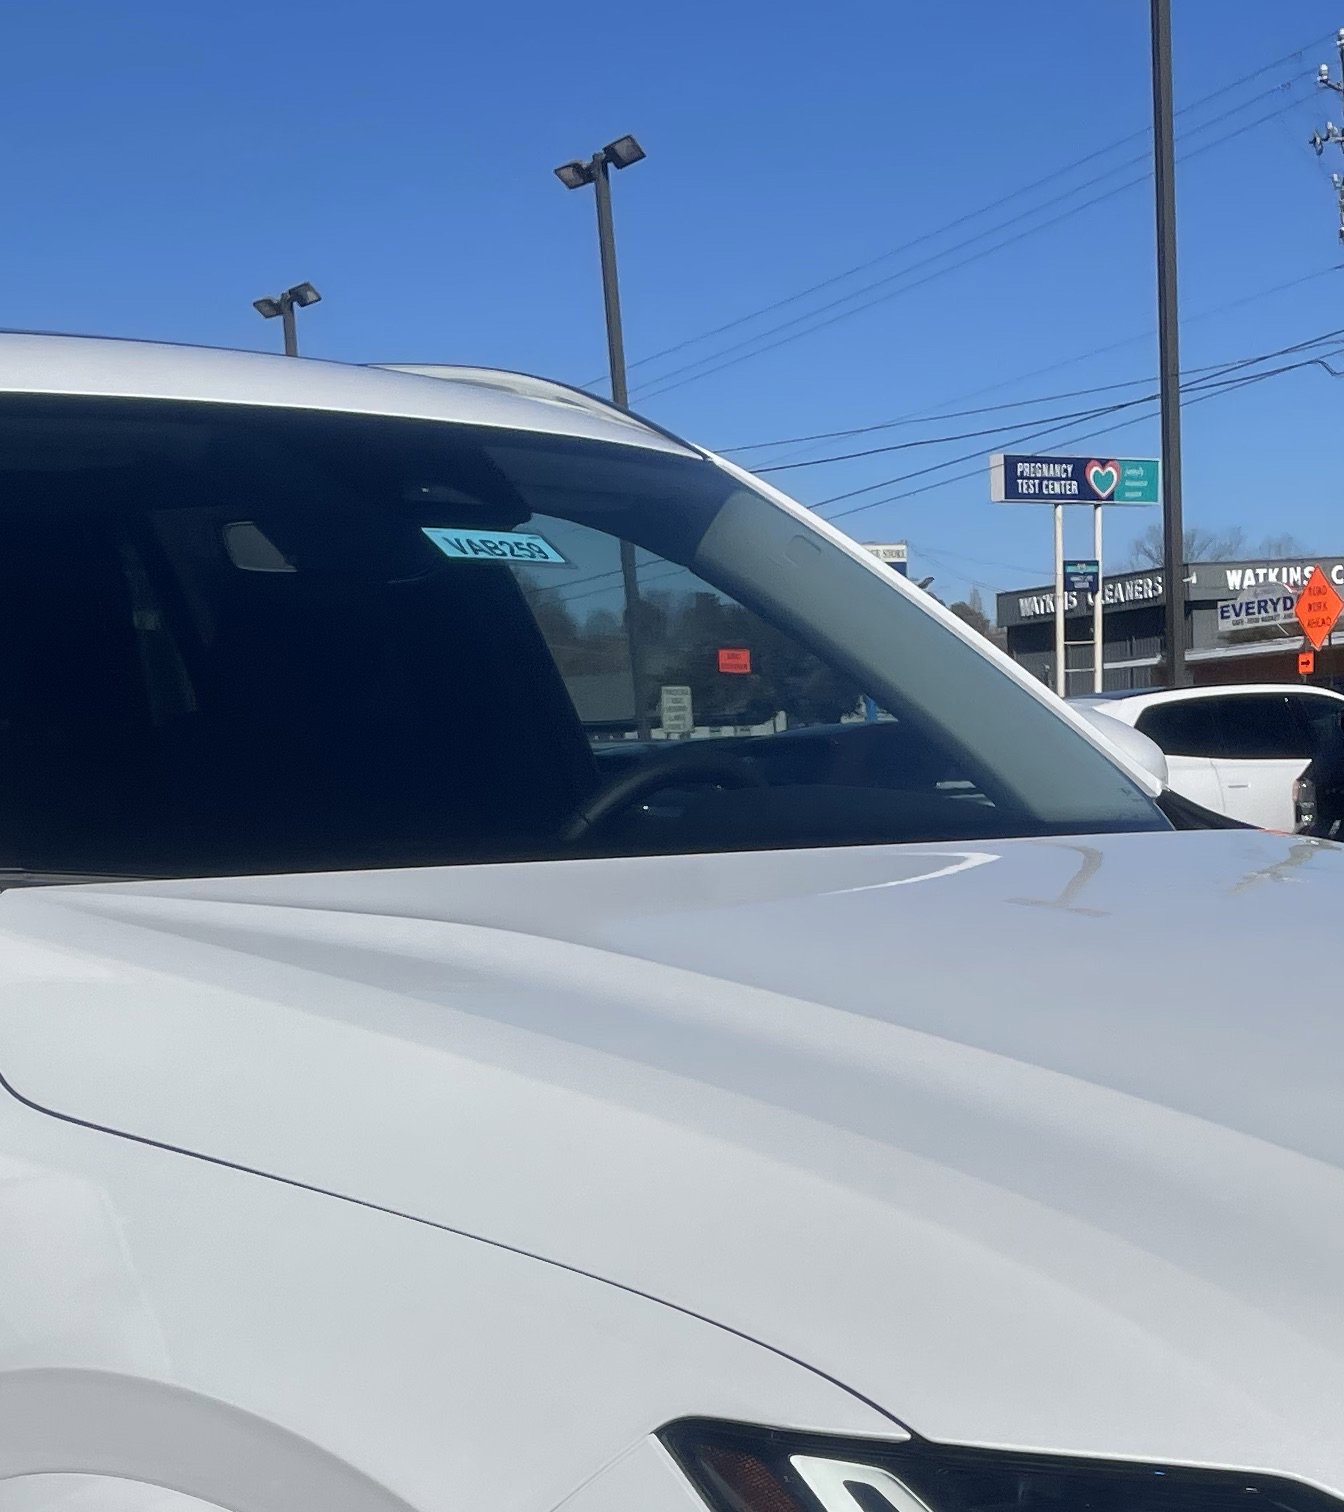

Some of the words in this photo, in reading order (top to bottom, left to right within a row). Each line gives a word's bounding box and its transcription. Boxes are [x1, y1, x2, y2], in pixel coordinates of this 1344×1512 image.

[1017, 462, 1073, 478] PREGNANCY
[1017, 479, 1039, 494] TEST
[1042, 480, 1078, 495] CENTER
[442, 537, 549, 560] VAB259
[1087, 576, 1163, 607] CEANERS
[1220, 596, 1295, 619] EVERYD
